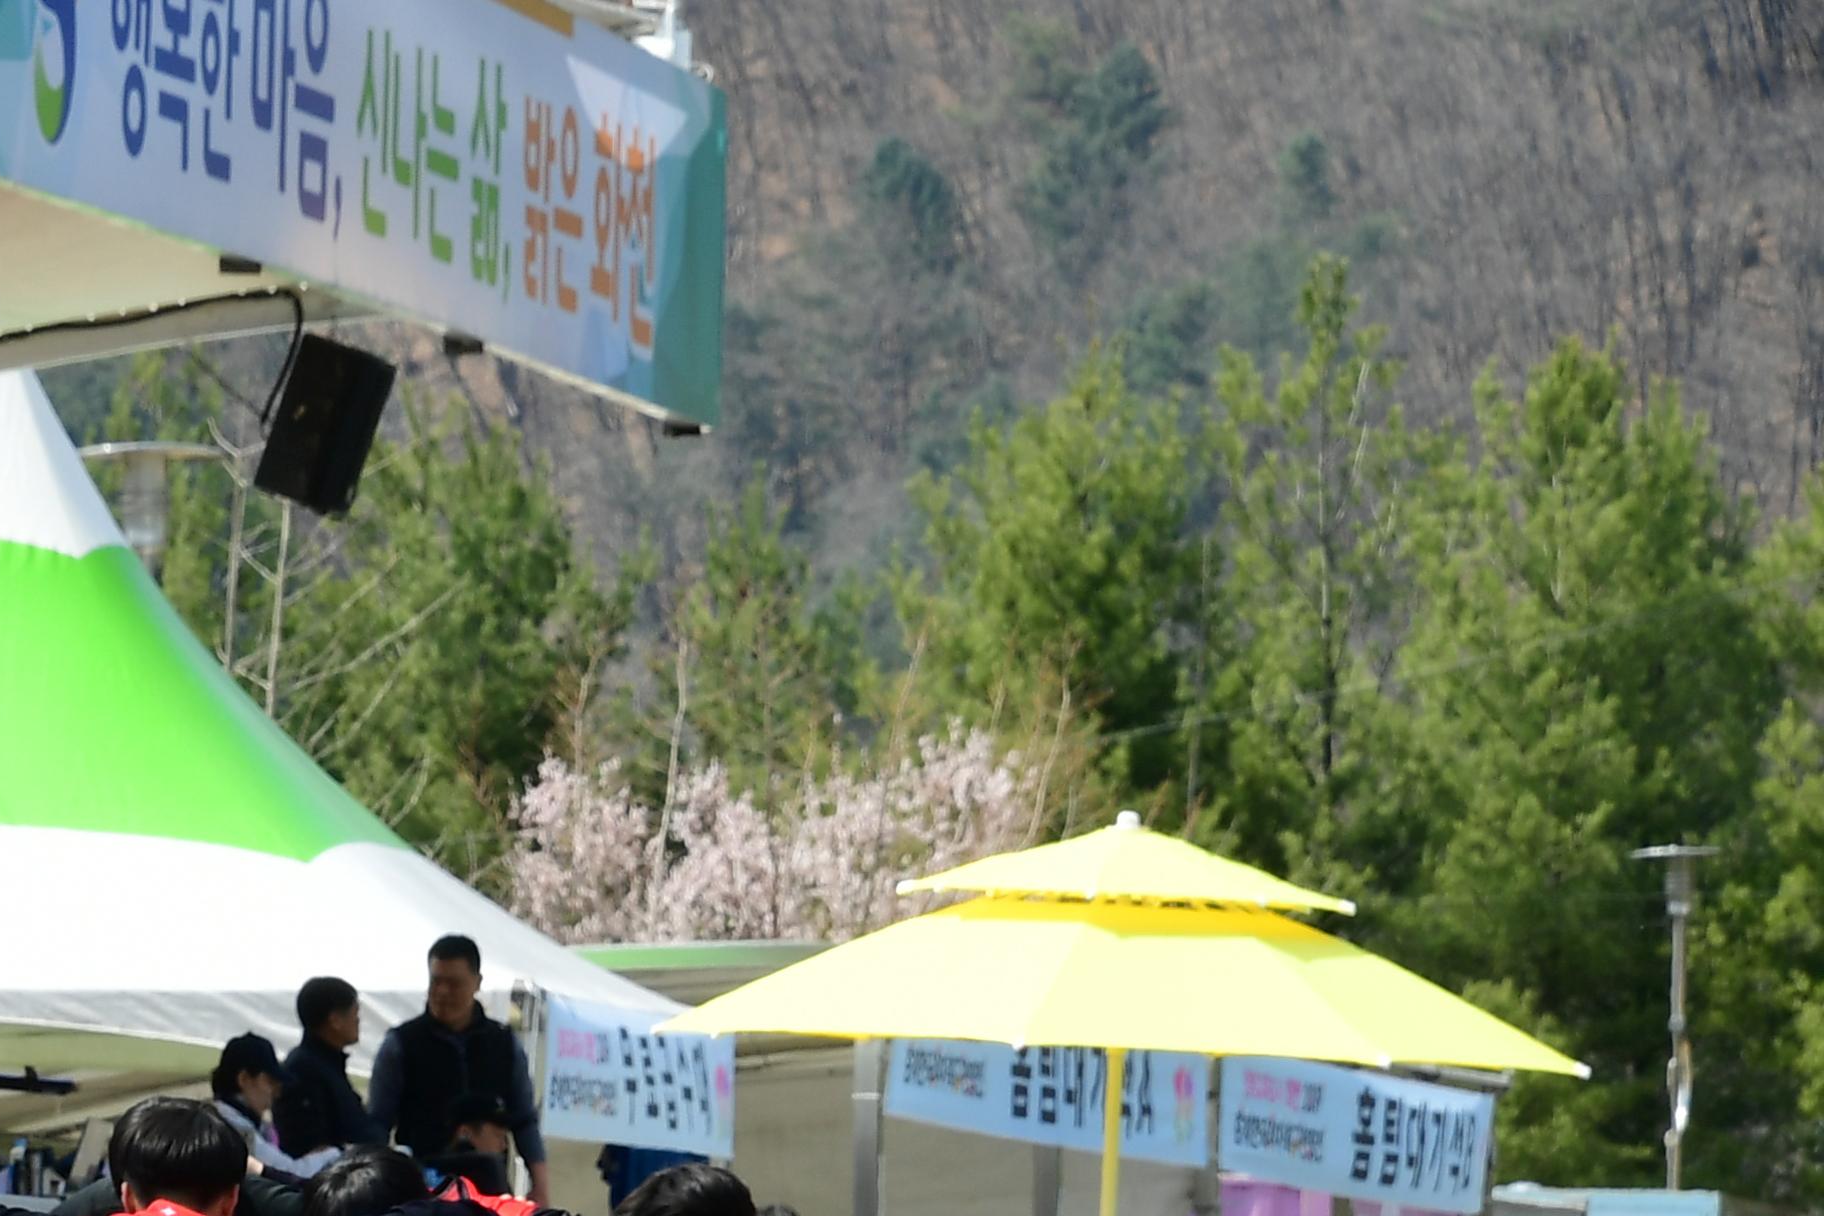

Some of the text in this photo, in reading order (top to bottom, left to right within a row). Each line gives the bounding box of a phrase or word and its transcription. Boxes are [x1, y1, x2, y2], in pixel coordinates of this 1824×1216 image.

[357, 29, 460, 264] 신나는
[523, 94, 584, 314] 밝은
[590, 112, 658, 347] 화천
